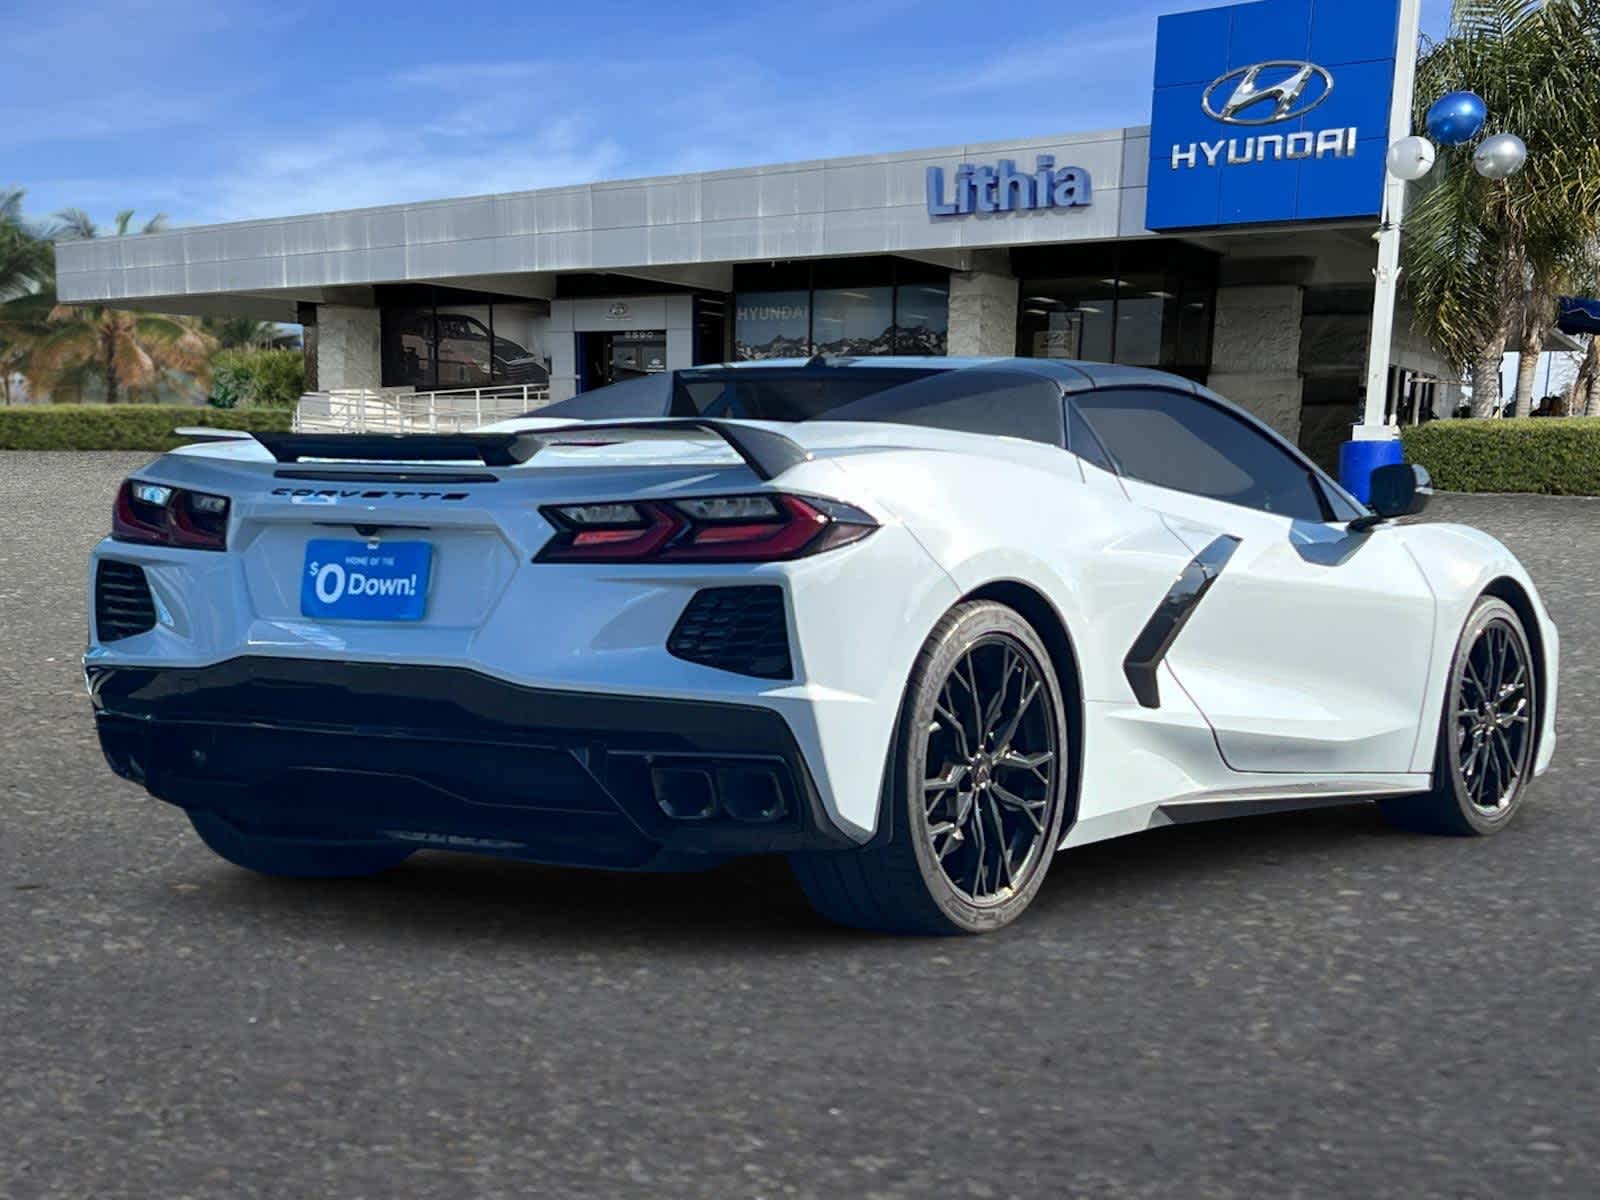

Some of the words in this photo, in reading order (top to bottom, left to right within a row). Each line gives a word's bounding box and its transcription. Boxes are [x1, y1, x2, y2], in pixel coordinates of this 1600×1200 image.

[1171, 127, 1357, 169] HYUNDAI
[926, 154, 1092, 216] Lithia
[737, 304, 808, 320] HYUNDAI
[271, 488, 470, 500] CORVETTE
[348, 573, 417, 595] Down!
